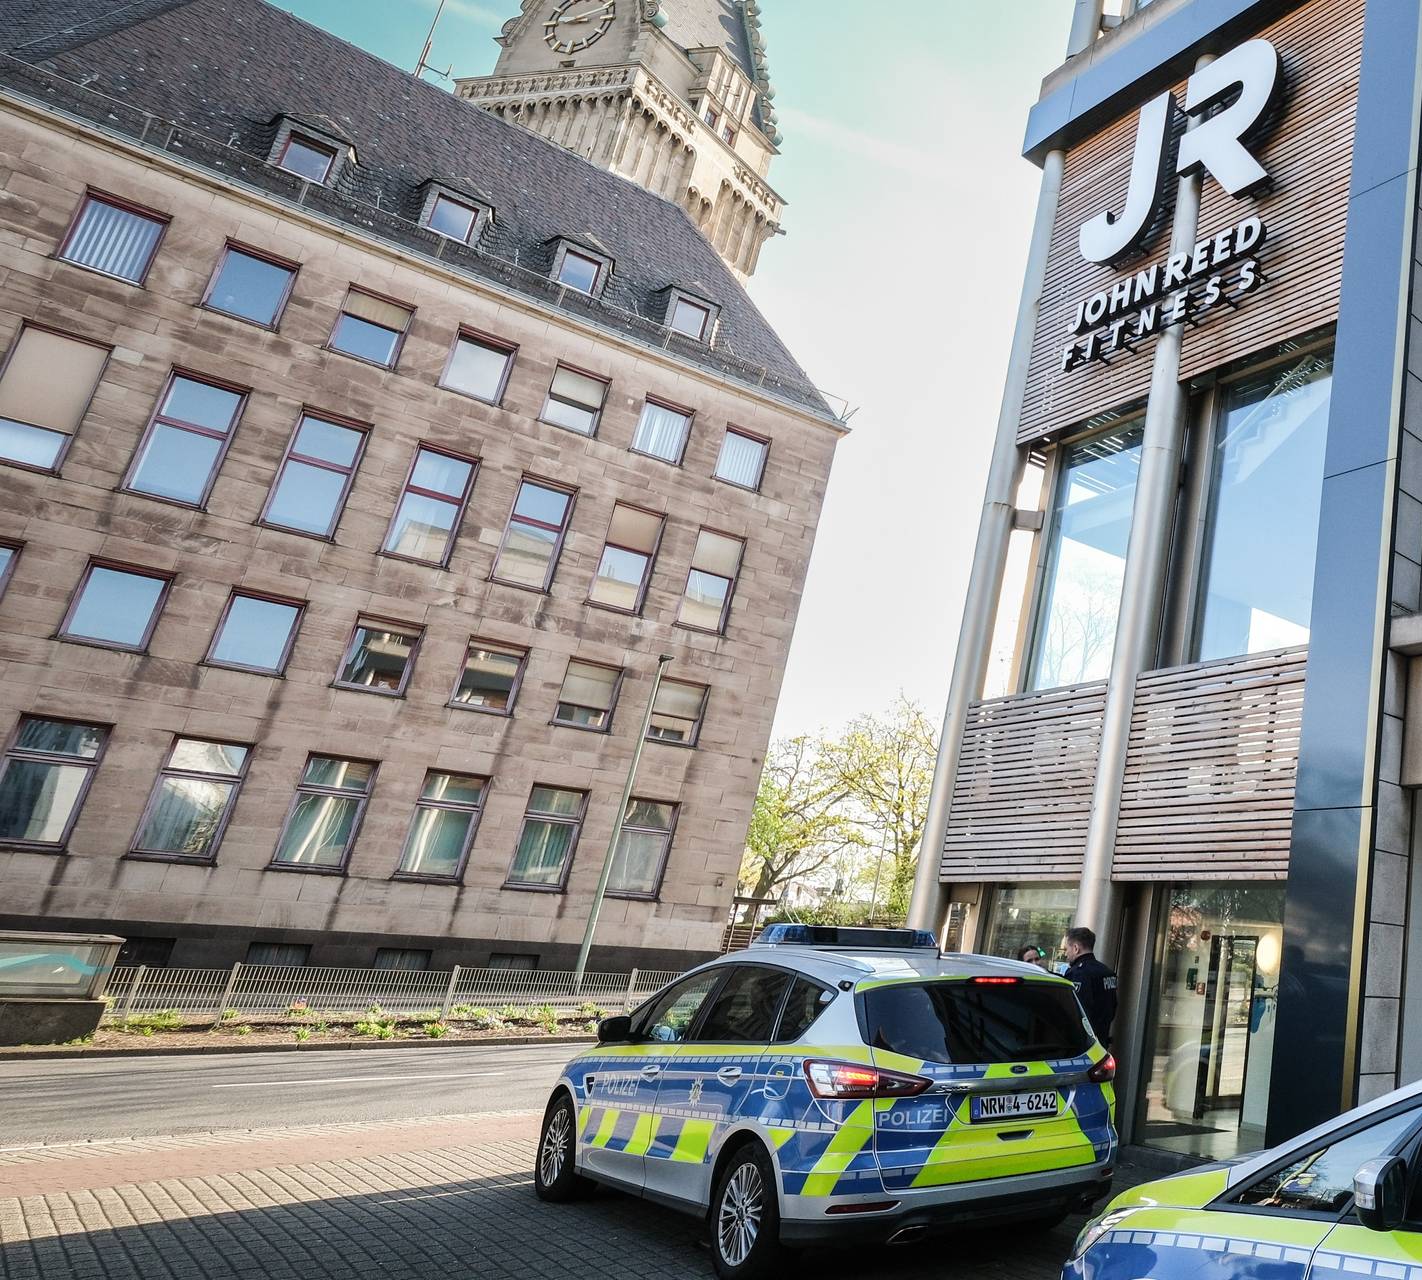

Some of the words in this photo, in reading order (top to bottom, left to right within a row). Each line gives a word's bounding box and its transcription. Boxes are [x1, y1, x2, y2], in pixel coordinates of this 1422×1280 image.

[1079, 38, 1278, 263] JR
[1067, 264, 1158, 333] JOHN
[1163, 216, 1262, 289] REED
[1061, 260, 1257, 371] FITNESS
[600, 1073, 641, 1097] POLIZEI
[878, 1108, 948, 1128] POLIZEI
[980, 1096, 1006, 1116] NRW
[1012, 1092, 1057, 1112] 4-6242
